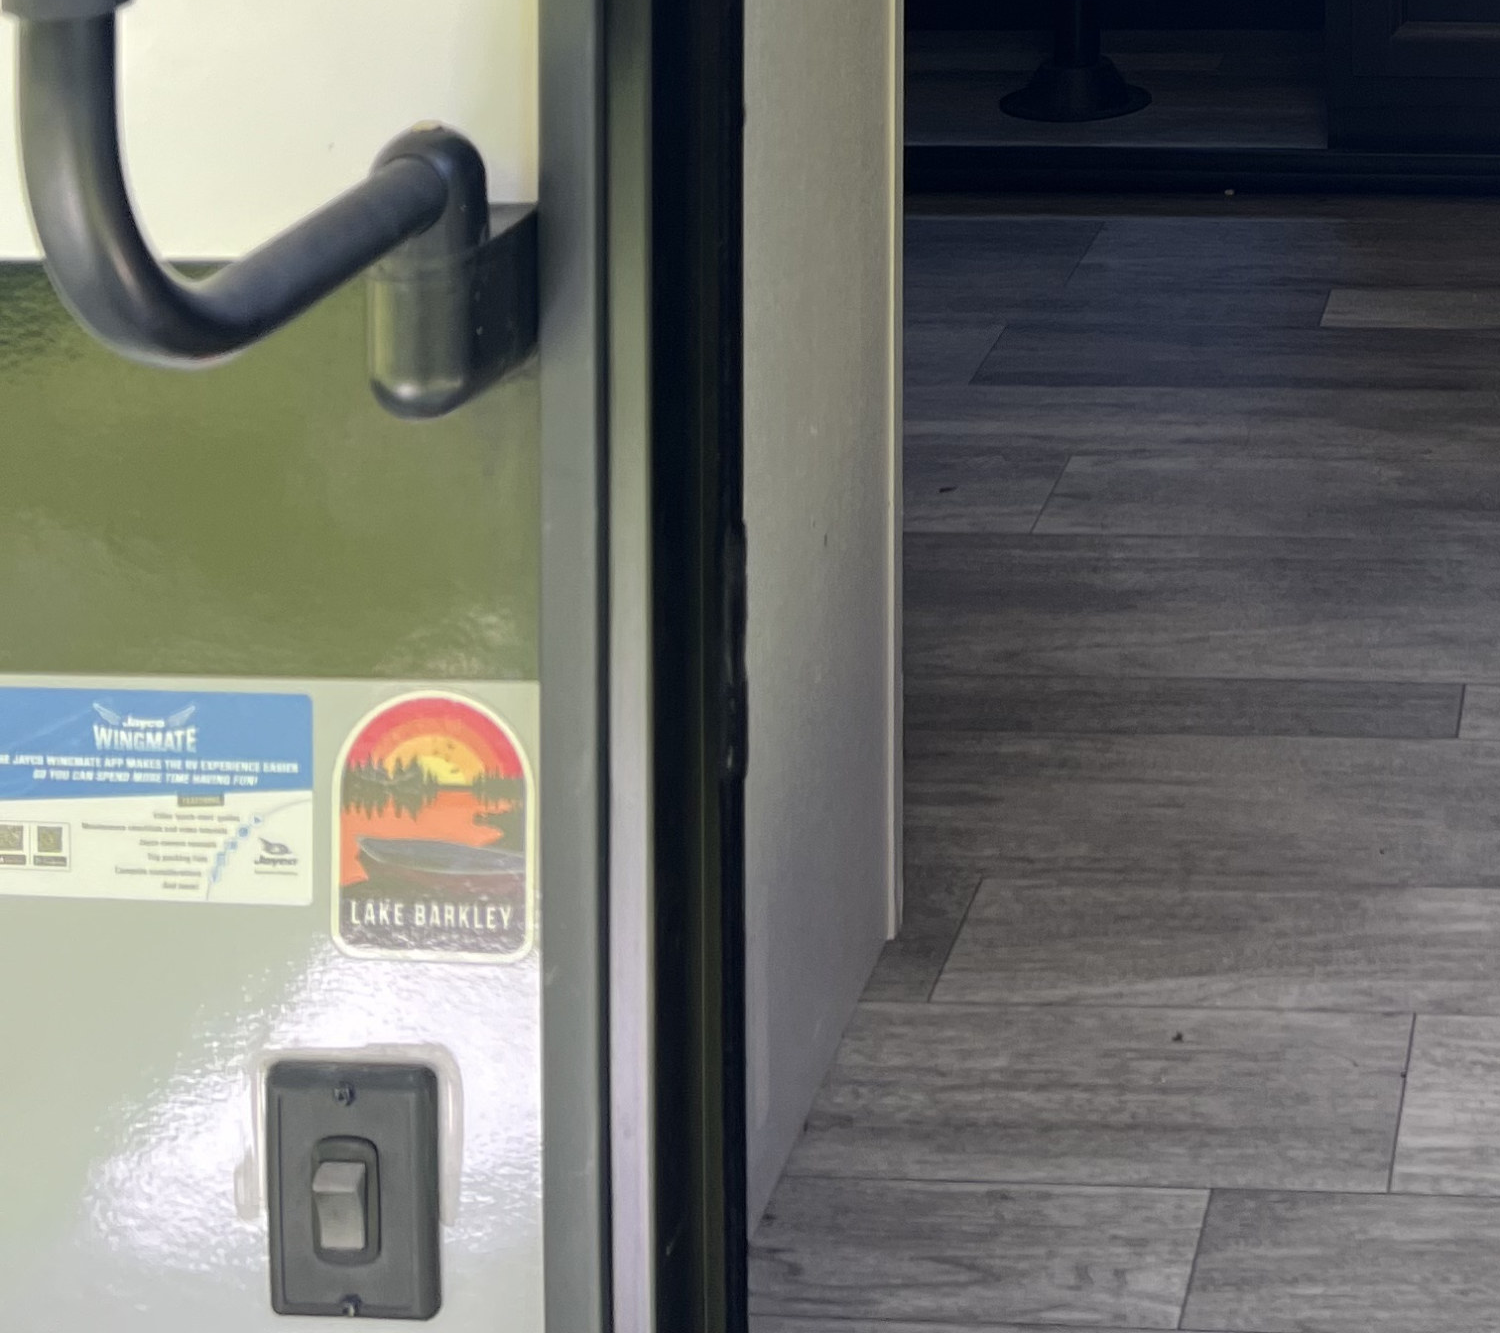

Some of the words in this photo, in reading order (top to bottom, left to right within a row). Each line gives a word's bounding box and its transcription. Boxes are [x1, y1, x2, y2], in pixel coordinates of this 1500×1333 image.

[92, 724, 200, 753] WINGMATE
[350, 898, 404, 927] LAKE
[414, 902, 513, 930] BARKLEY
